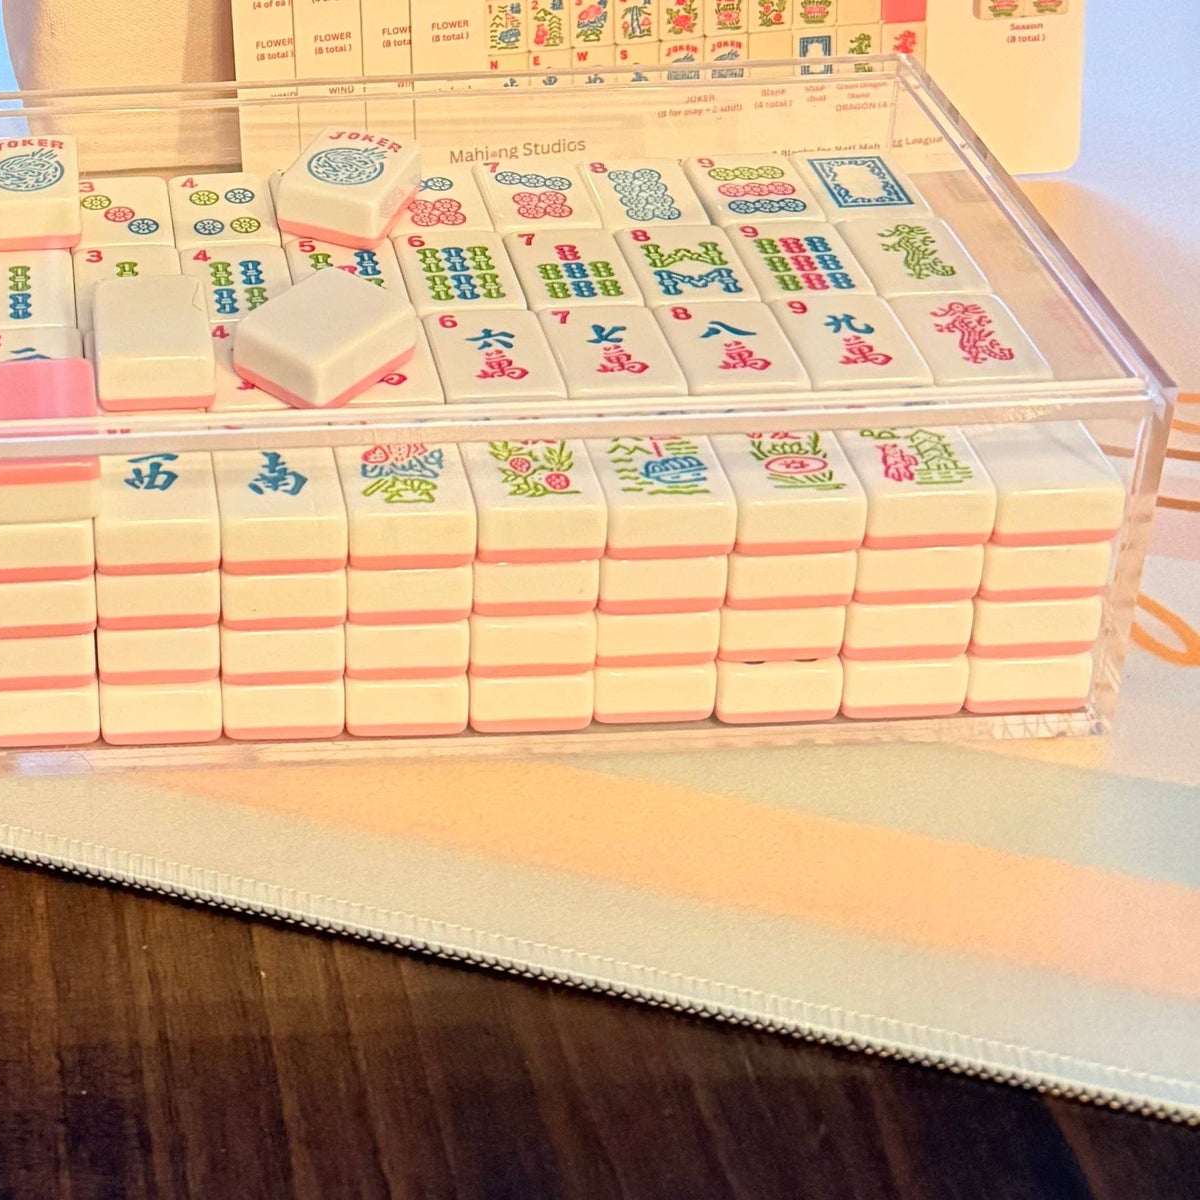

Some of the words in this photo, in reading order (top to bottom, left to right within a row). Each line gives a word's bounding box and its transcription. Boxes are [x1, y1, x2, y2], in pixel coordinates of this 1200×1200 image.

[263, 0, 273, 8] of
[431, 20, 469, 31] FLOWER
[1010, 22, 1044, 31] Season
[314, 32, 352, 43] FLOWER
[442, 32, 464, 41] total
[1018, 33, 1041, 43] total
[255, 38, 294, 49] FLOWER
[326, 44, 347, 54] total
[267, 51, 289, 60] total
[329, 130, 402, 154] JOKER
[522, 139, 587, 157] Studios
[483, 163, 500, 173] 7
[589, 162, 608, 174] 8
[697, 157, 715, 169] 9
[80, 181, 95, 193] 3
[181, 178, 198, 189] 4
[630, 229, 651, 242] 8
[739, 226, 759, 238] 9
[407, 235, 425, 248] 6
[518, 233, 535, 246] 7
[299, 240, 316, 252] 5
[87, 251, 103, 262] 3
[193, 250, 211, 262] 4
[671, 306, 692, 320] 8
[788, 301, 808, 314] 9
[438, 315, 458, 328] 6
[551, 310, 570, 324] 7
[212, 325, 229, 339] 4
[125, 453, 179, 491] 西
[247, 451, 308, 496] 南
